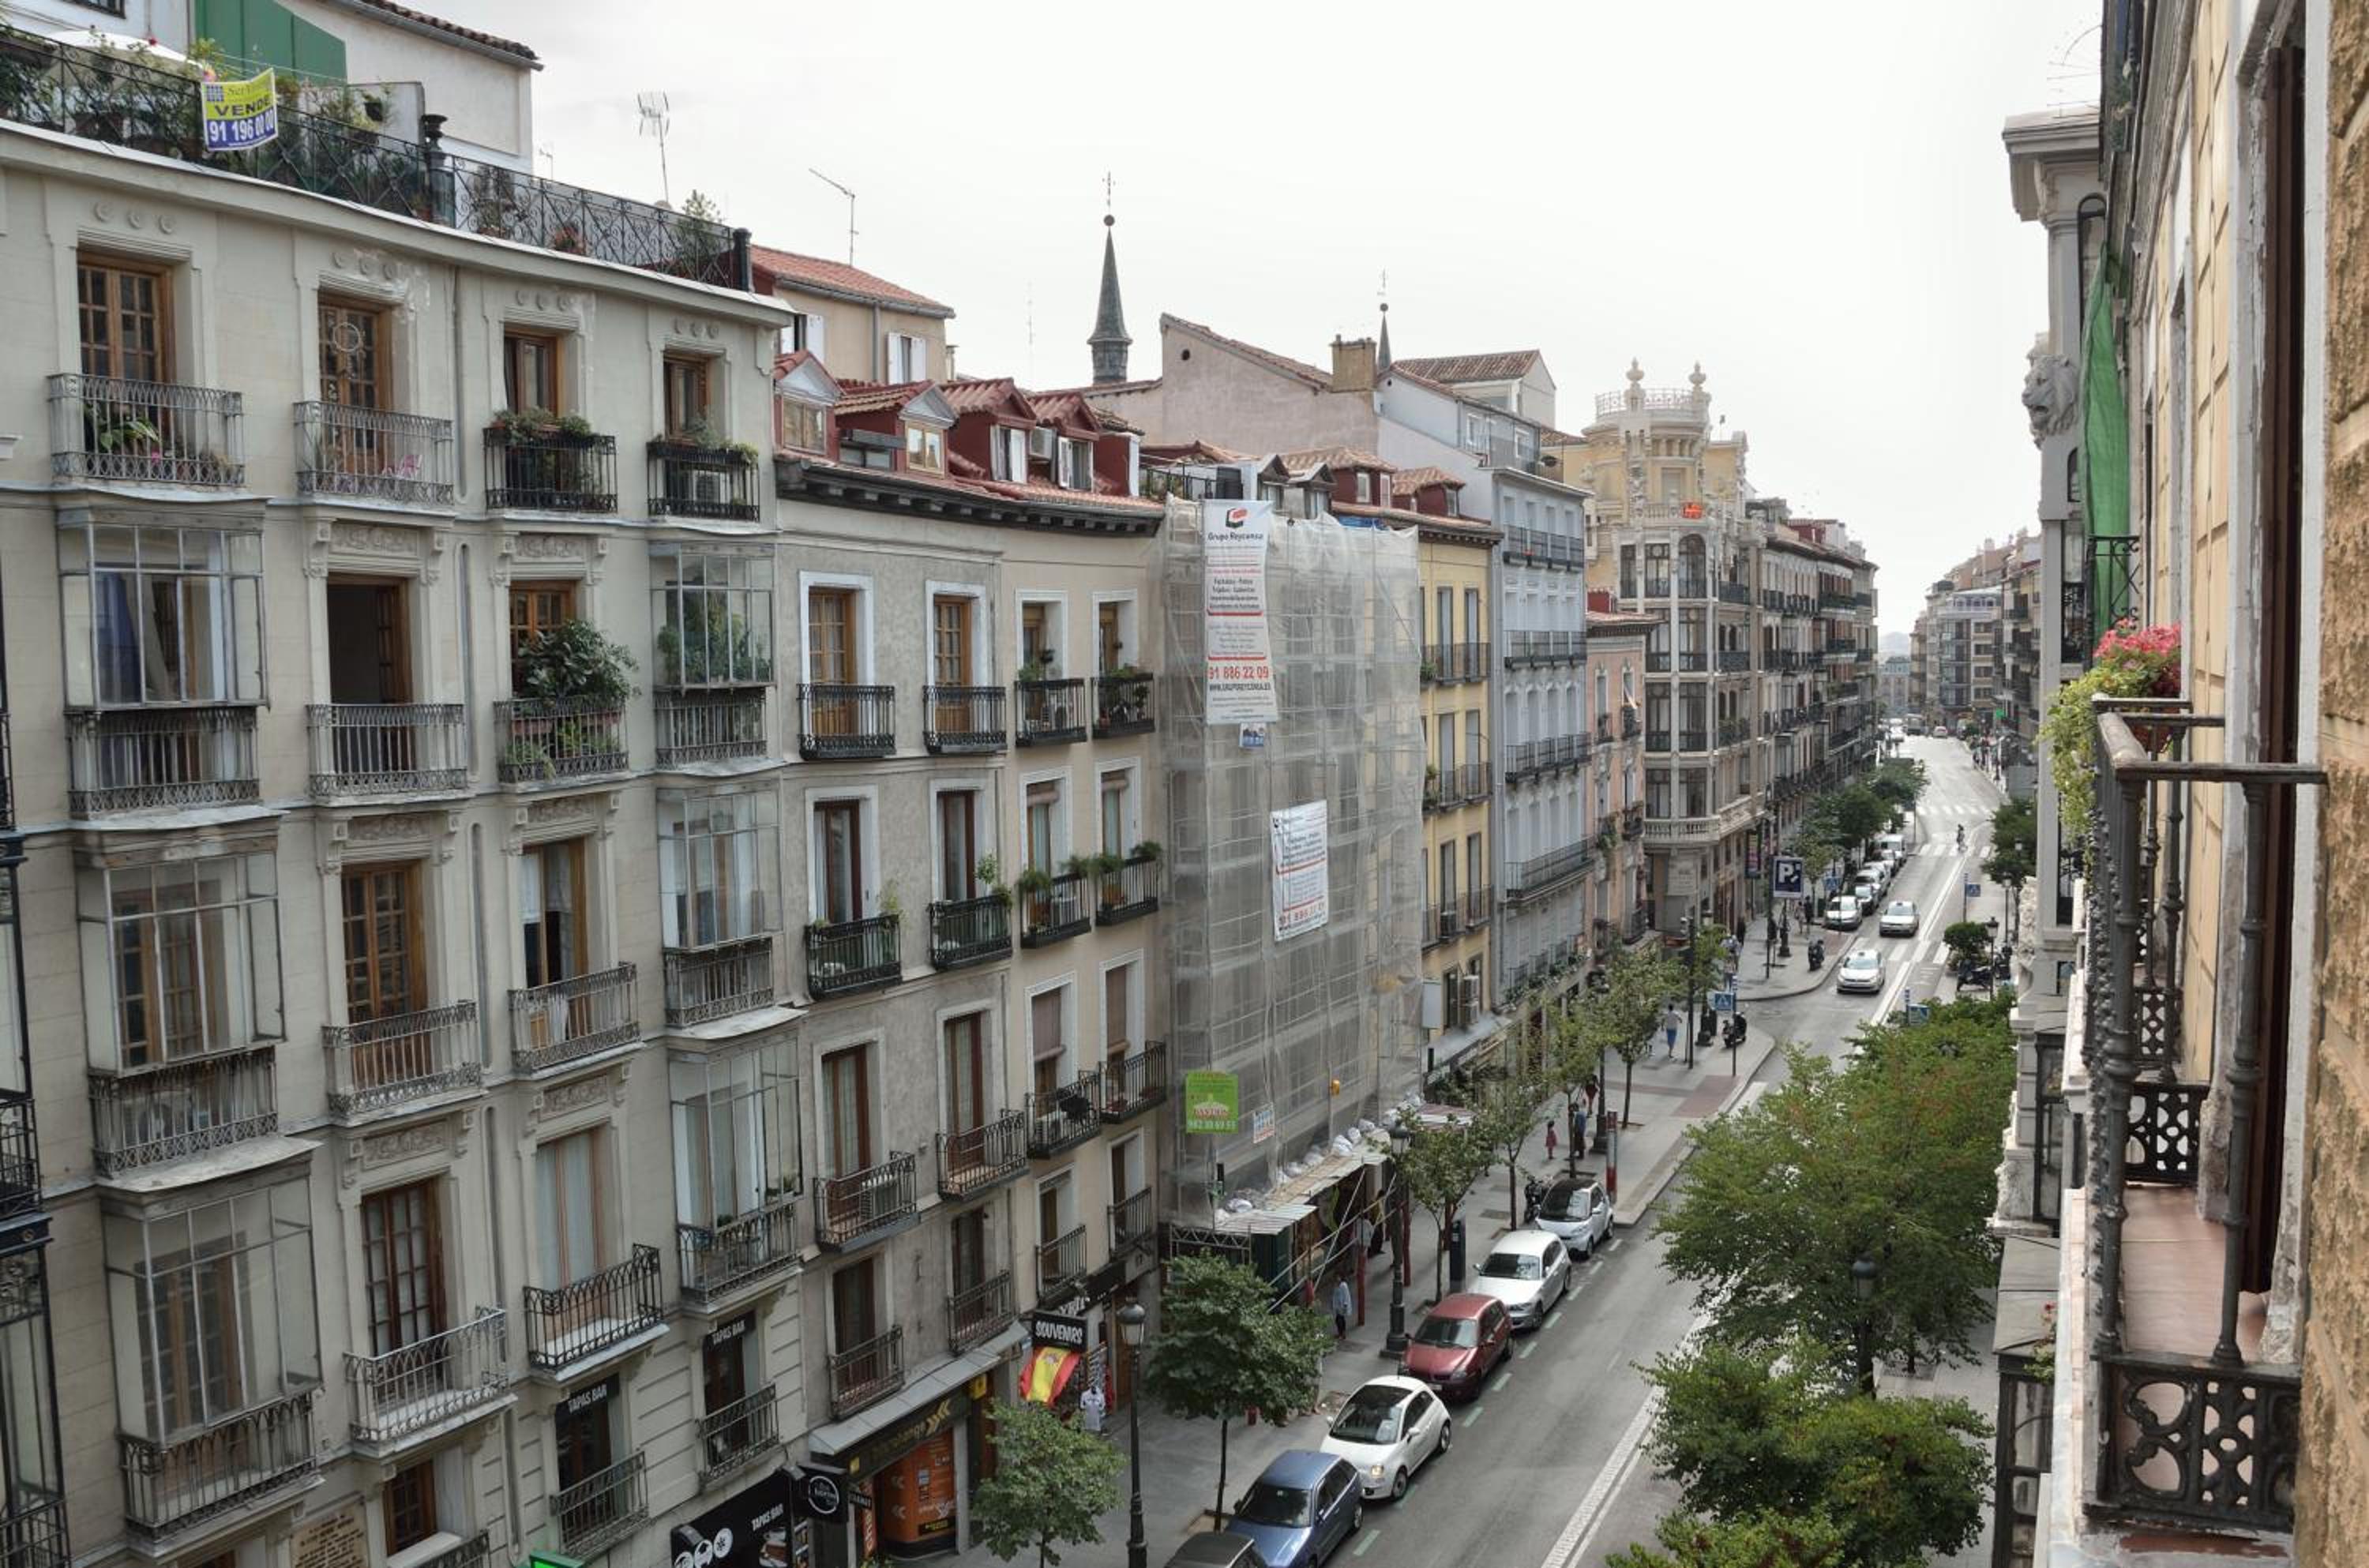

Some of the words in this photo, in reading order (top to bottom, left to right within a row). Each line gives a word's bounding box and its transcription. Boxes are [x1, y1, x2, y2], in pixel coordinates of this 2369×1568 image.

[214, 94, 271, 116] VENDE
[209, 121, 227, 141] 91
[231, 118, 253, 141] 196
[1207, 532, 1228, 542] Grupo
[1242, 666, 1255, 679] 22
[711, 1326, 732, 1346] TAPAS
[732, 1319, 745, 1336] BAR
[1035, 1320, 1083, 1345] SOUVENIRS
[568, 1390, 591, 1413] TAPAS
[591, 1384, 606, 1401] BAR
[751, 1510, 771, 1531] TAPAS
[770, 1502, 784, 1521] BAR
